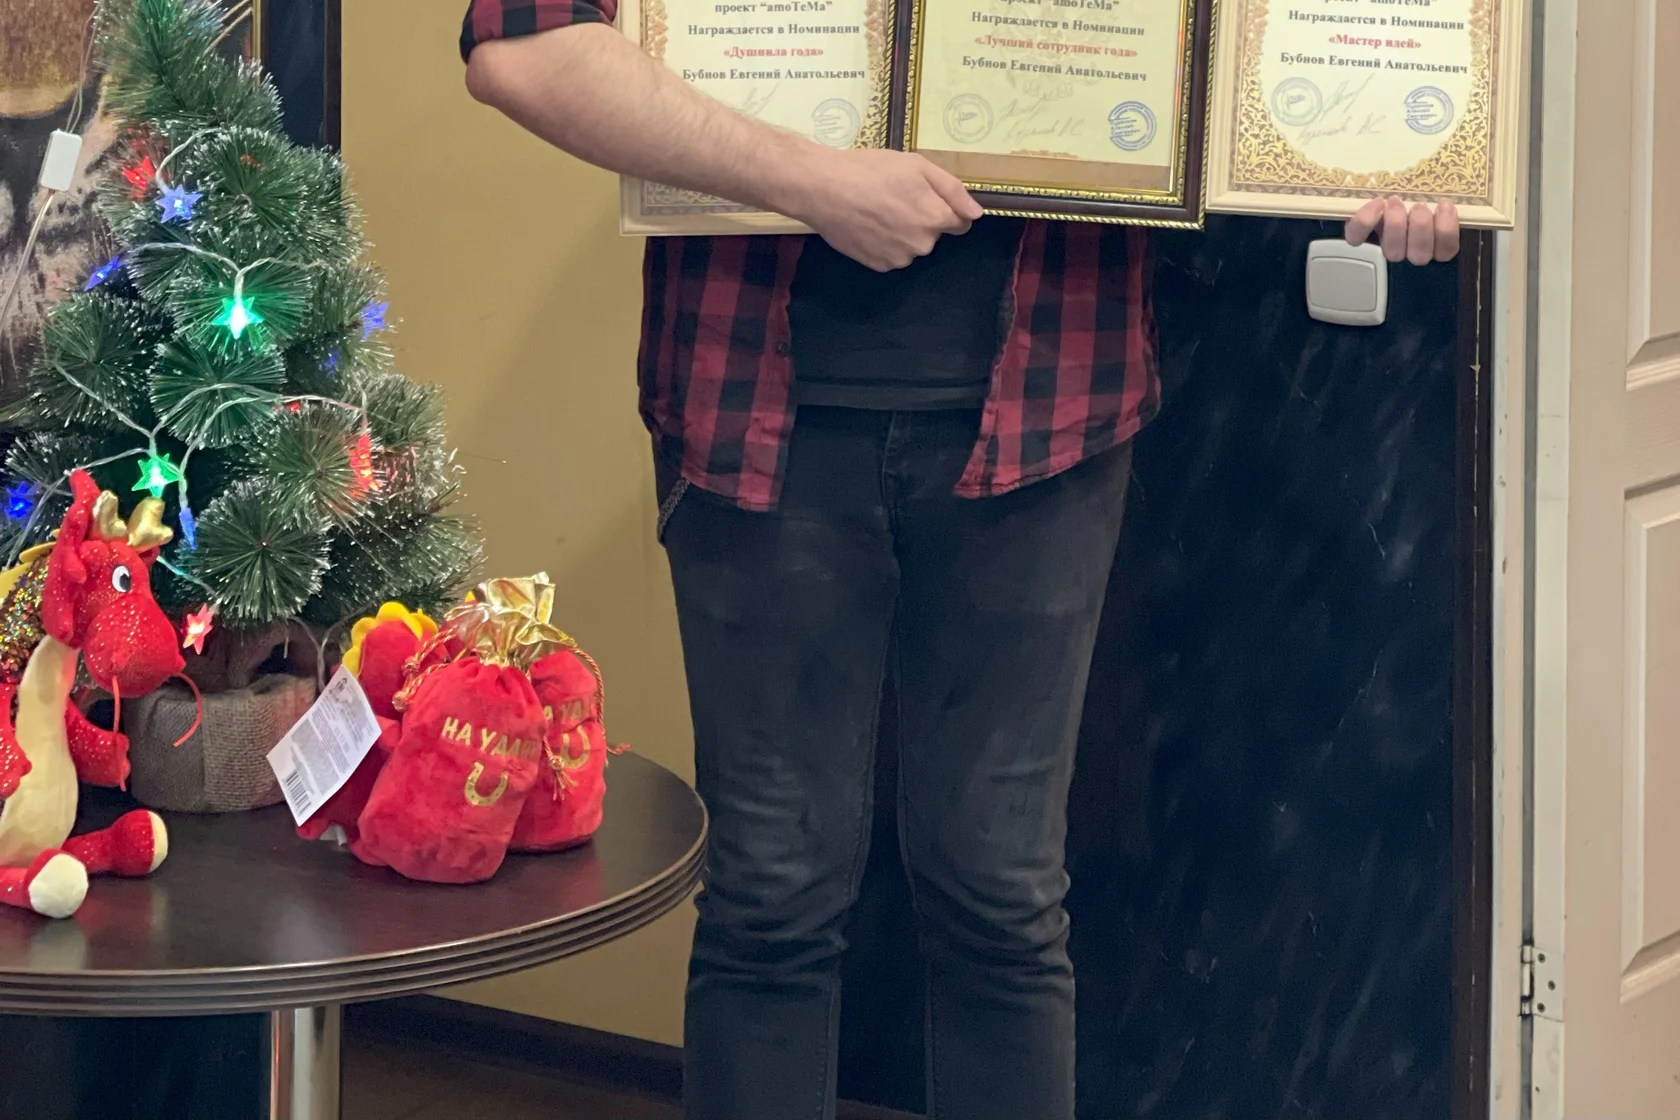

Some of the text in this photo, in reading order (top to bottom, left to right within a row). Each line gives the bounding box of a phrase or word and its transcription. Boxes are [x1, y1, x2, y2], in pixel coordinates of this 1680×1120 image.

[715, 4, 757, 15] проект
[971, 11, 1145, 36] Награждается в Номинации
[1289, 10, 1464, 30] Награждается в Номинации
[688, 25, 774, 37] Награждается
[788, 24, 860, 35] Номинации
[974, 34, 1138, 57] «Лучший сотрудник года»
[1328, 34, 1422, 49] «Мастер идей»
[791, 48, 824, 57] года»
[962, 56, 1147, 81] Бубнов Евгений Анатольевич
[1280, 52, 1468, 74] Бубнов Евгений Анатольевич
[682, 69, 865, 82] Бубнов Евгений Анатольевич
[442, 716, 472, 746] НА
